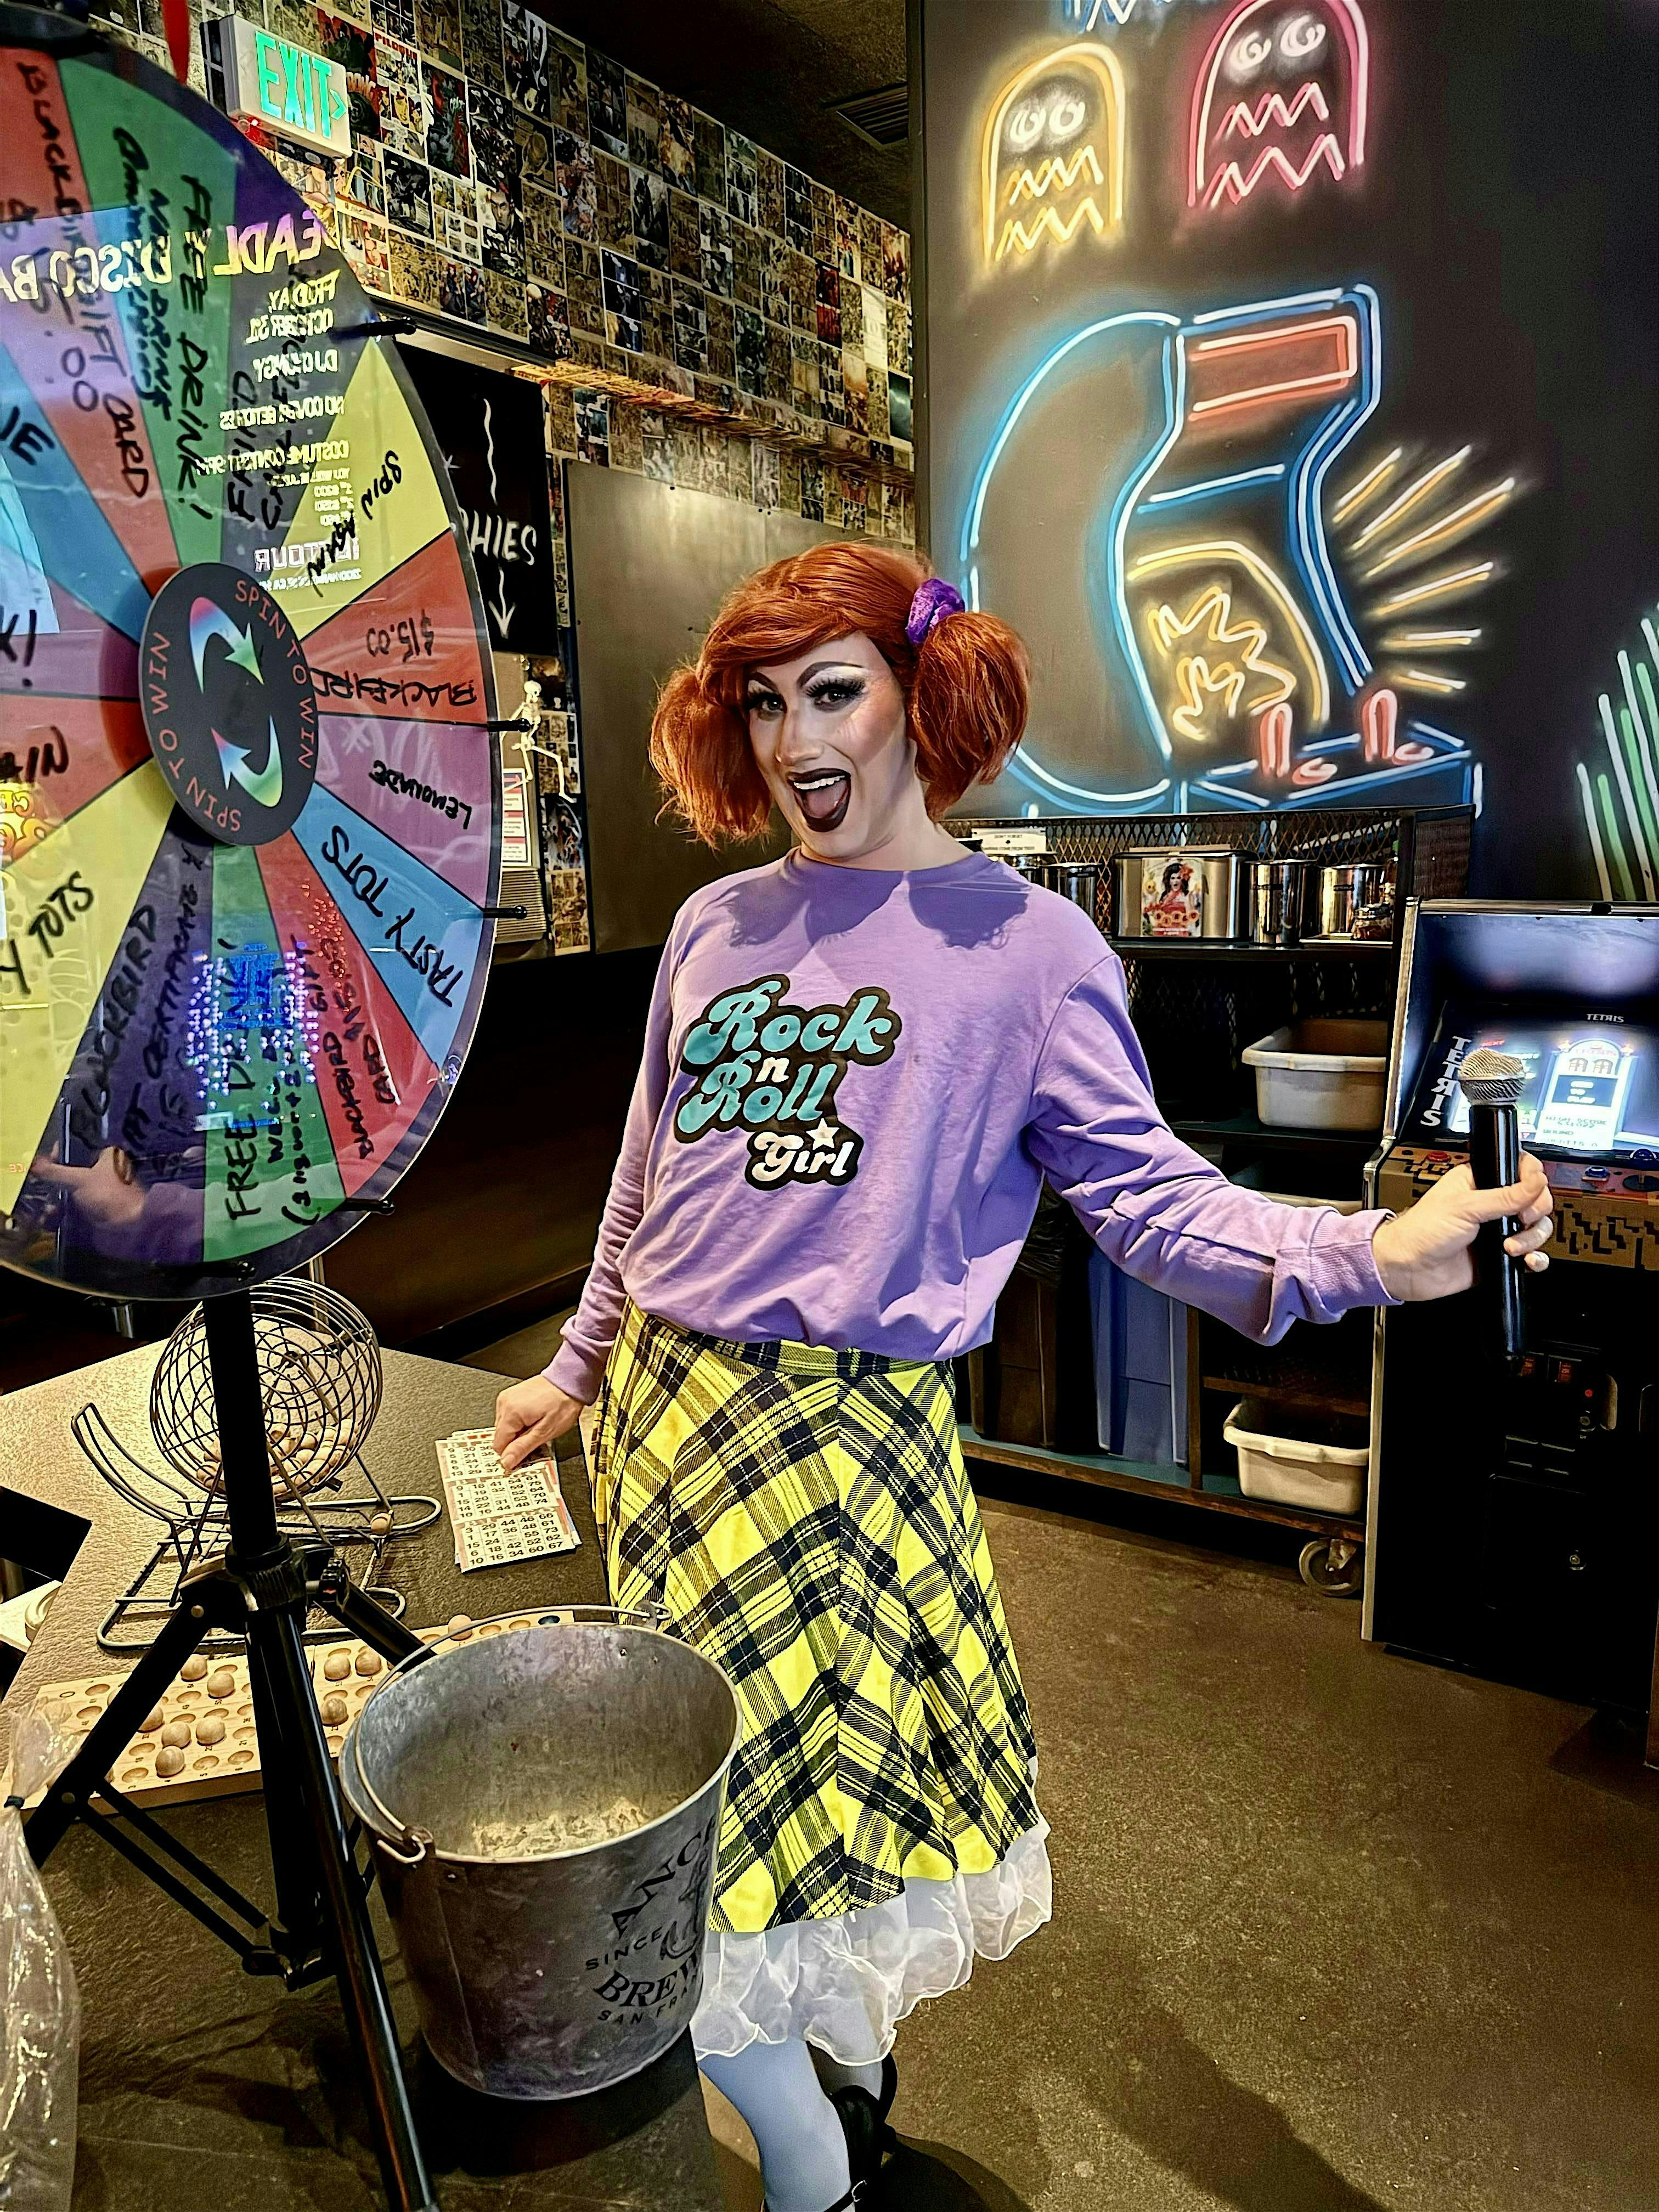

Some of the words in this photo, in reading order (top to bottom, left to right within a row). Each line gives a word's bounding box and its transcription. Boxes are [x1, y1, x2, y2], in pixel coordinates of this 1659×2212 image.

[256, 31, 332, 138] EXIT
[182, 174, 212, 314] FREE
[103, 391, 149, 498] CARD
[177, 332, 213, 520] DRINK!
[361, 450, 402, 520] SPIN
[149, 632, 171, 714] WIN
[235, 580, 286, 640] SPIN
[286, 640, 307, 684] TO
[297, 697, 314, 769] WIN
[309, 668, 477, 708] BLACKBIRD
[159, 729, 185, 780] TO
[369, 760, 472, 830] LEMONADE
[185, 776, 241, 832] SPIN
[321, 825, 388, 918] TOTS
[27, 871, 93, 958] TOTS
[386, 907, 463, 1007] TASTY
[683, 980, 892, 1065] Rock
[1587, 1013, 1624, 1023] TETRIS
[323, 1031, 374, 1159] BLACKBIRD
[677, 1050, 838, 1133] Roll
[1420, 1036, 1472, 1126] TETRIS
[224, 1113, 261, 1221] FREE
[752, 1119, 855, 1182] Girl
[585, 1926, 662, 1970] SINCE
[597, 2010, 644, 2025] SAN
